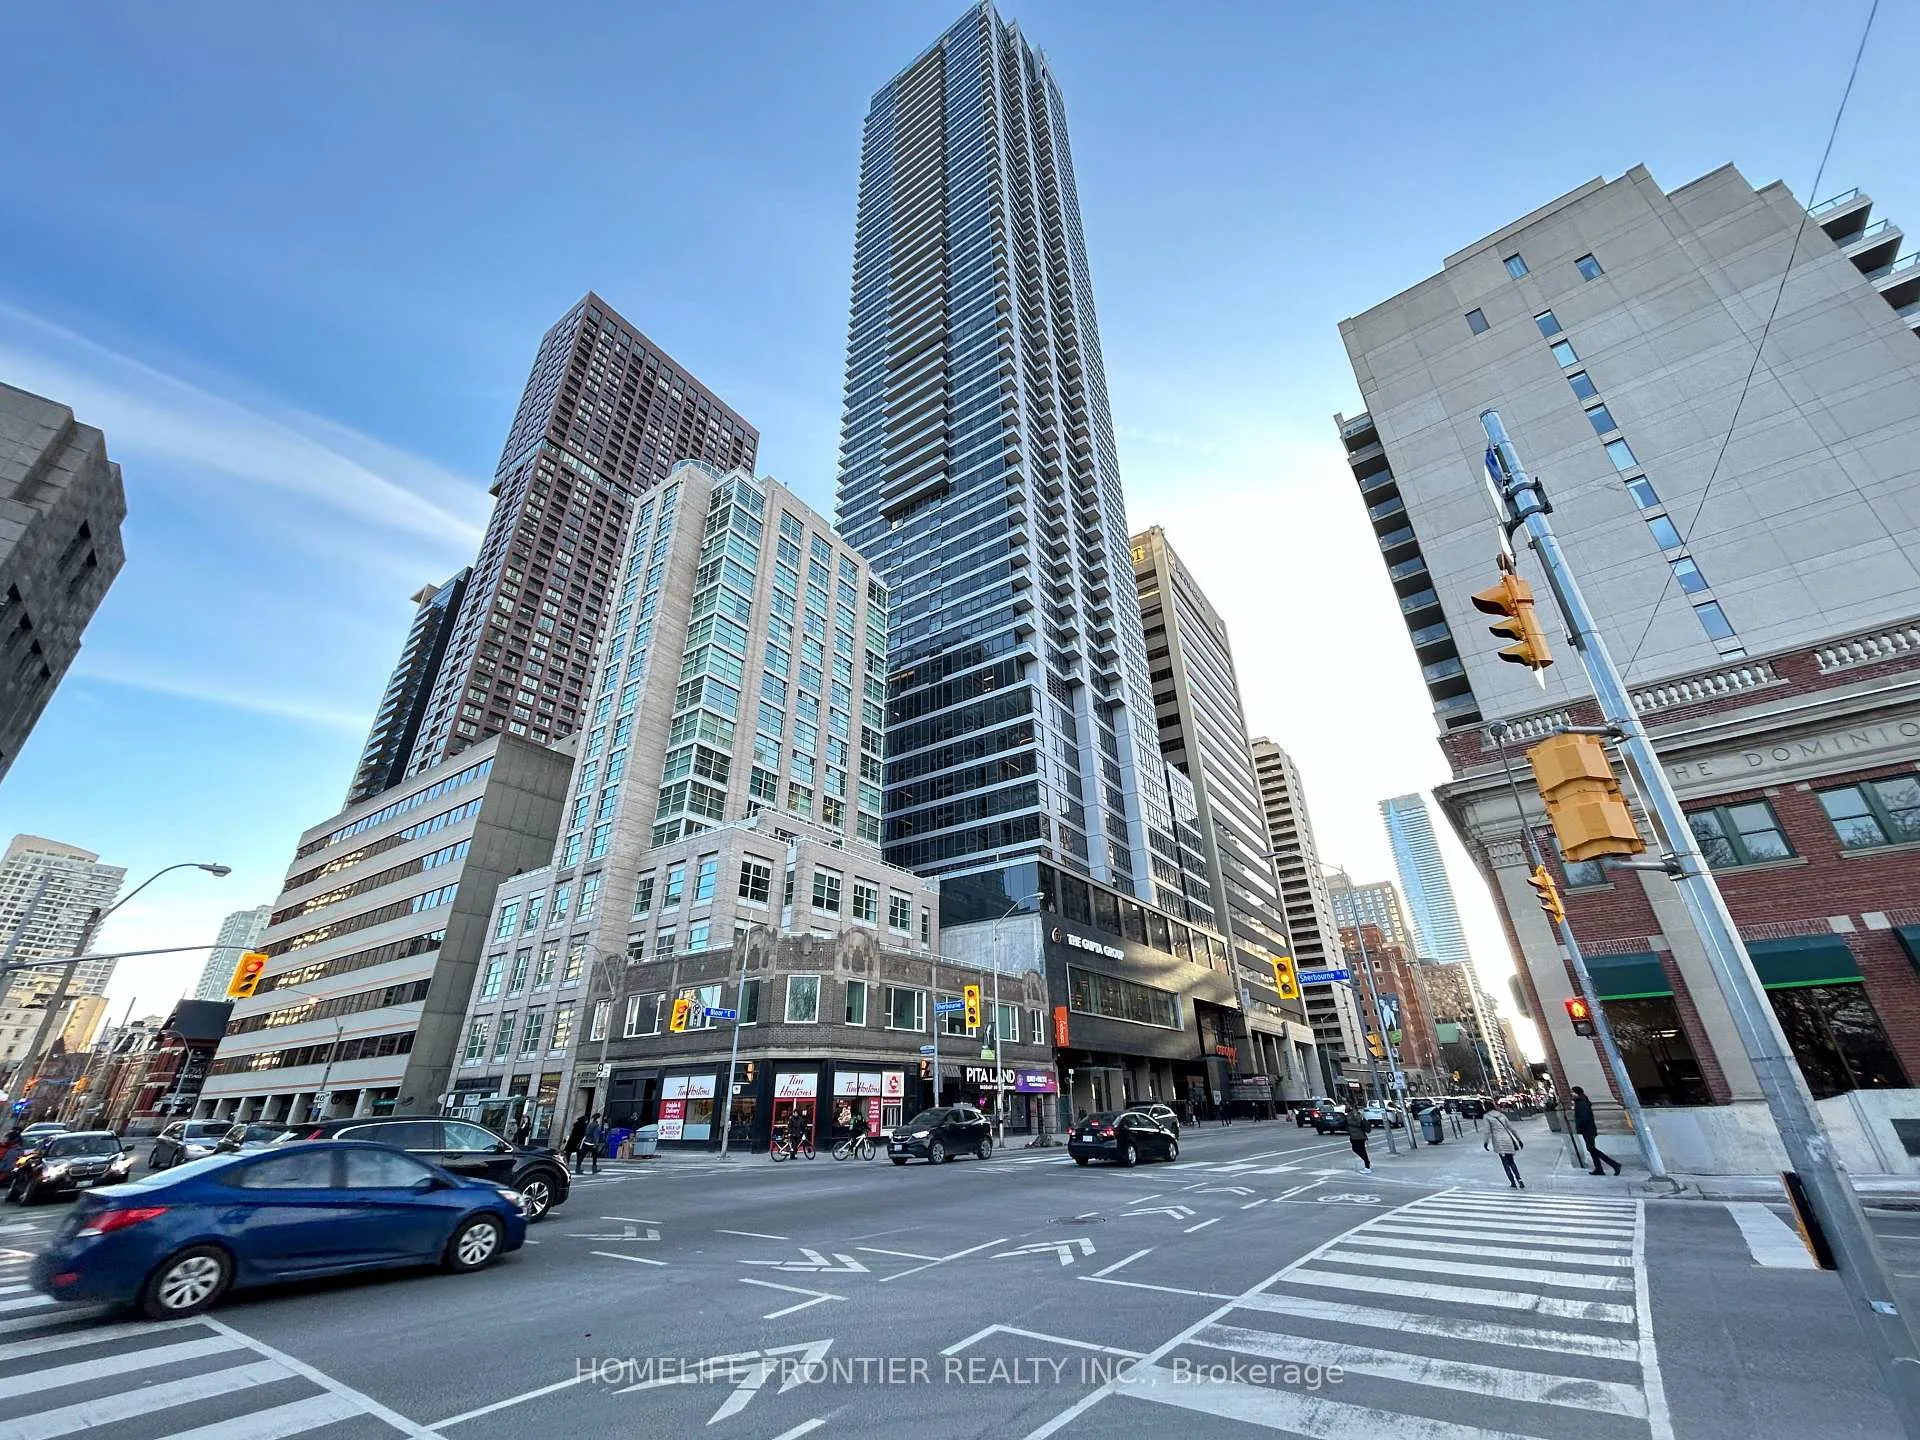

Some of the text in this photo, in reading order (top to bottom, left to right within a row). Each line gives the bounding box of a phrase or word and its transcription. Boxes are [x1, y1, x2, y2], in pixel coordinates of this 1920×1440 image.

[1672, 761, 1713, 780] HE
[1067, 934, 1124, 960] THE GUPTA GROUP
[1300, 973, 1334, 982] Sherbourne
[788, 1074, 804, 1085] Tim
[966, 1067, 988, 1082] PITA
[780, 1086, 812, 1097] Hortons
